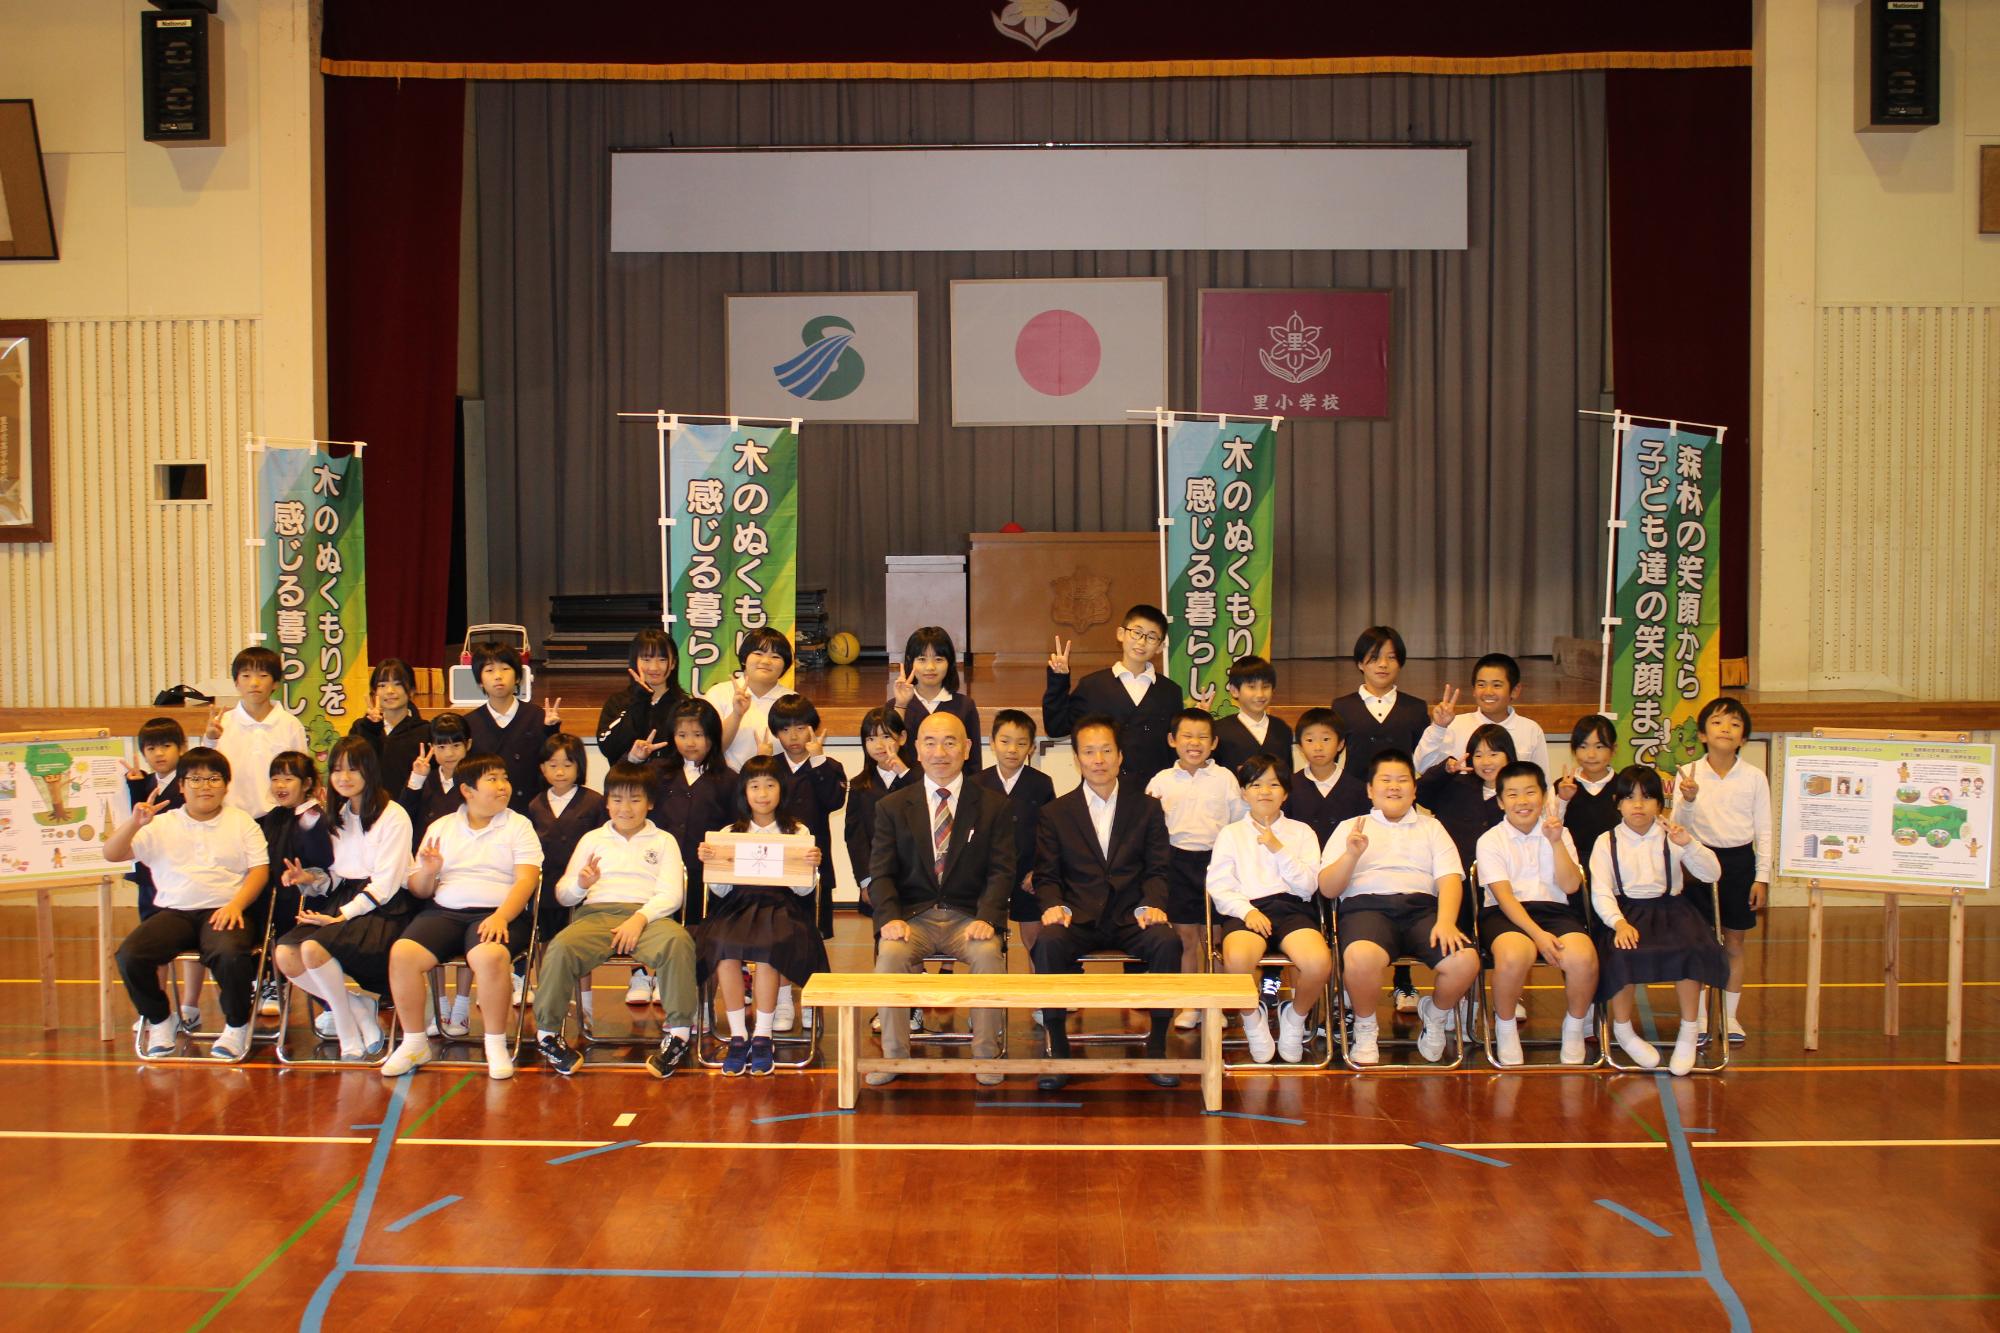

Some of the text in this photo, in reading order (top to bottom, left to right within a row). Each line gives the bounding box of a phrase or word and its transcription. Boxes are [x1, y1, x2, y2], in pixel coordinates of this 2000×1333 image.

[1252, 393, 1341, 412] 里小学校
[274, 500, 307, 716] 感じる暮らし
[312, 463, 347, 716] 木のぬくもりを
[732, 438, 769, 679] 木のぬくも
[1184, 476, 1217, 702] 感じる暮らし
[1221, 435, 1256, 692] 木のぬくもり
[1629, 438, 1671, 769] 子ども達の笑顔まで
[1675, 444, 1707, 700] 森林の笑顔から
